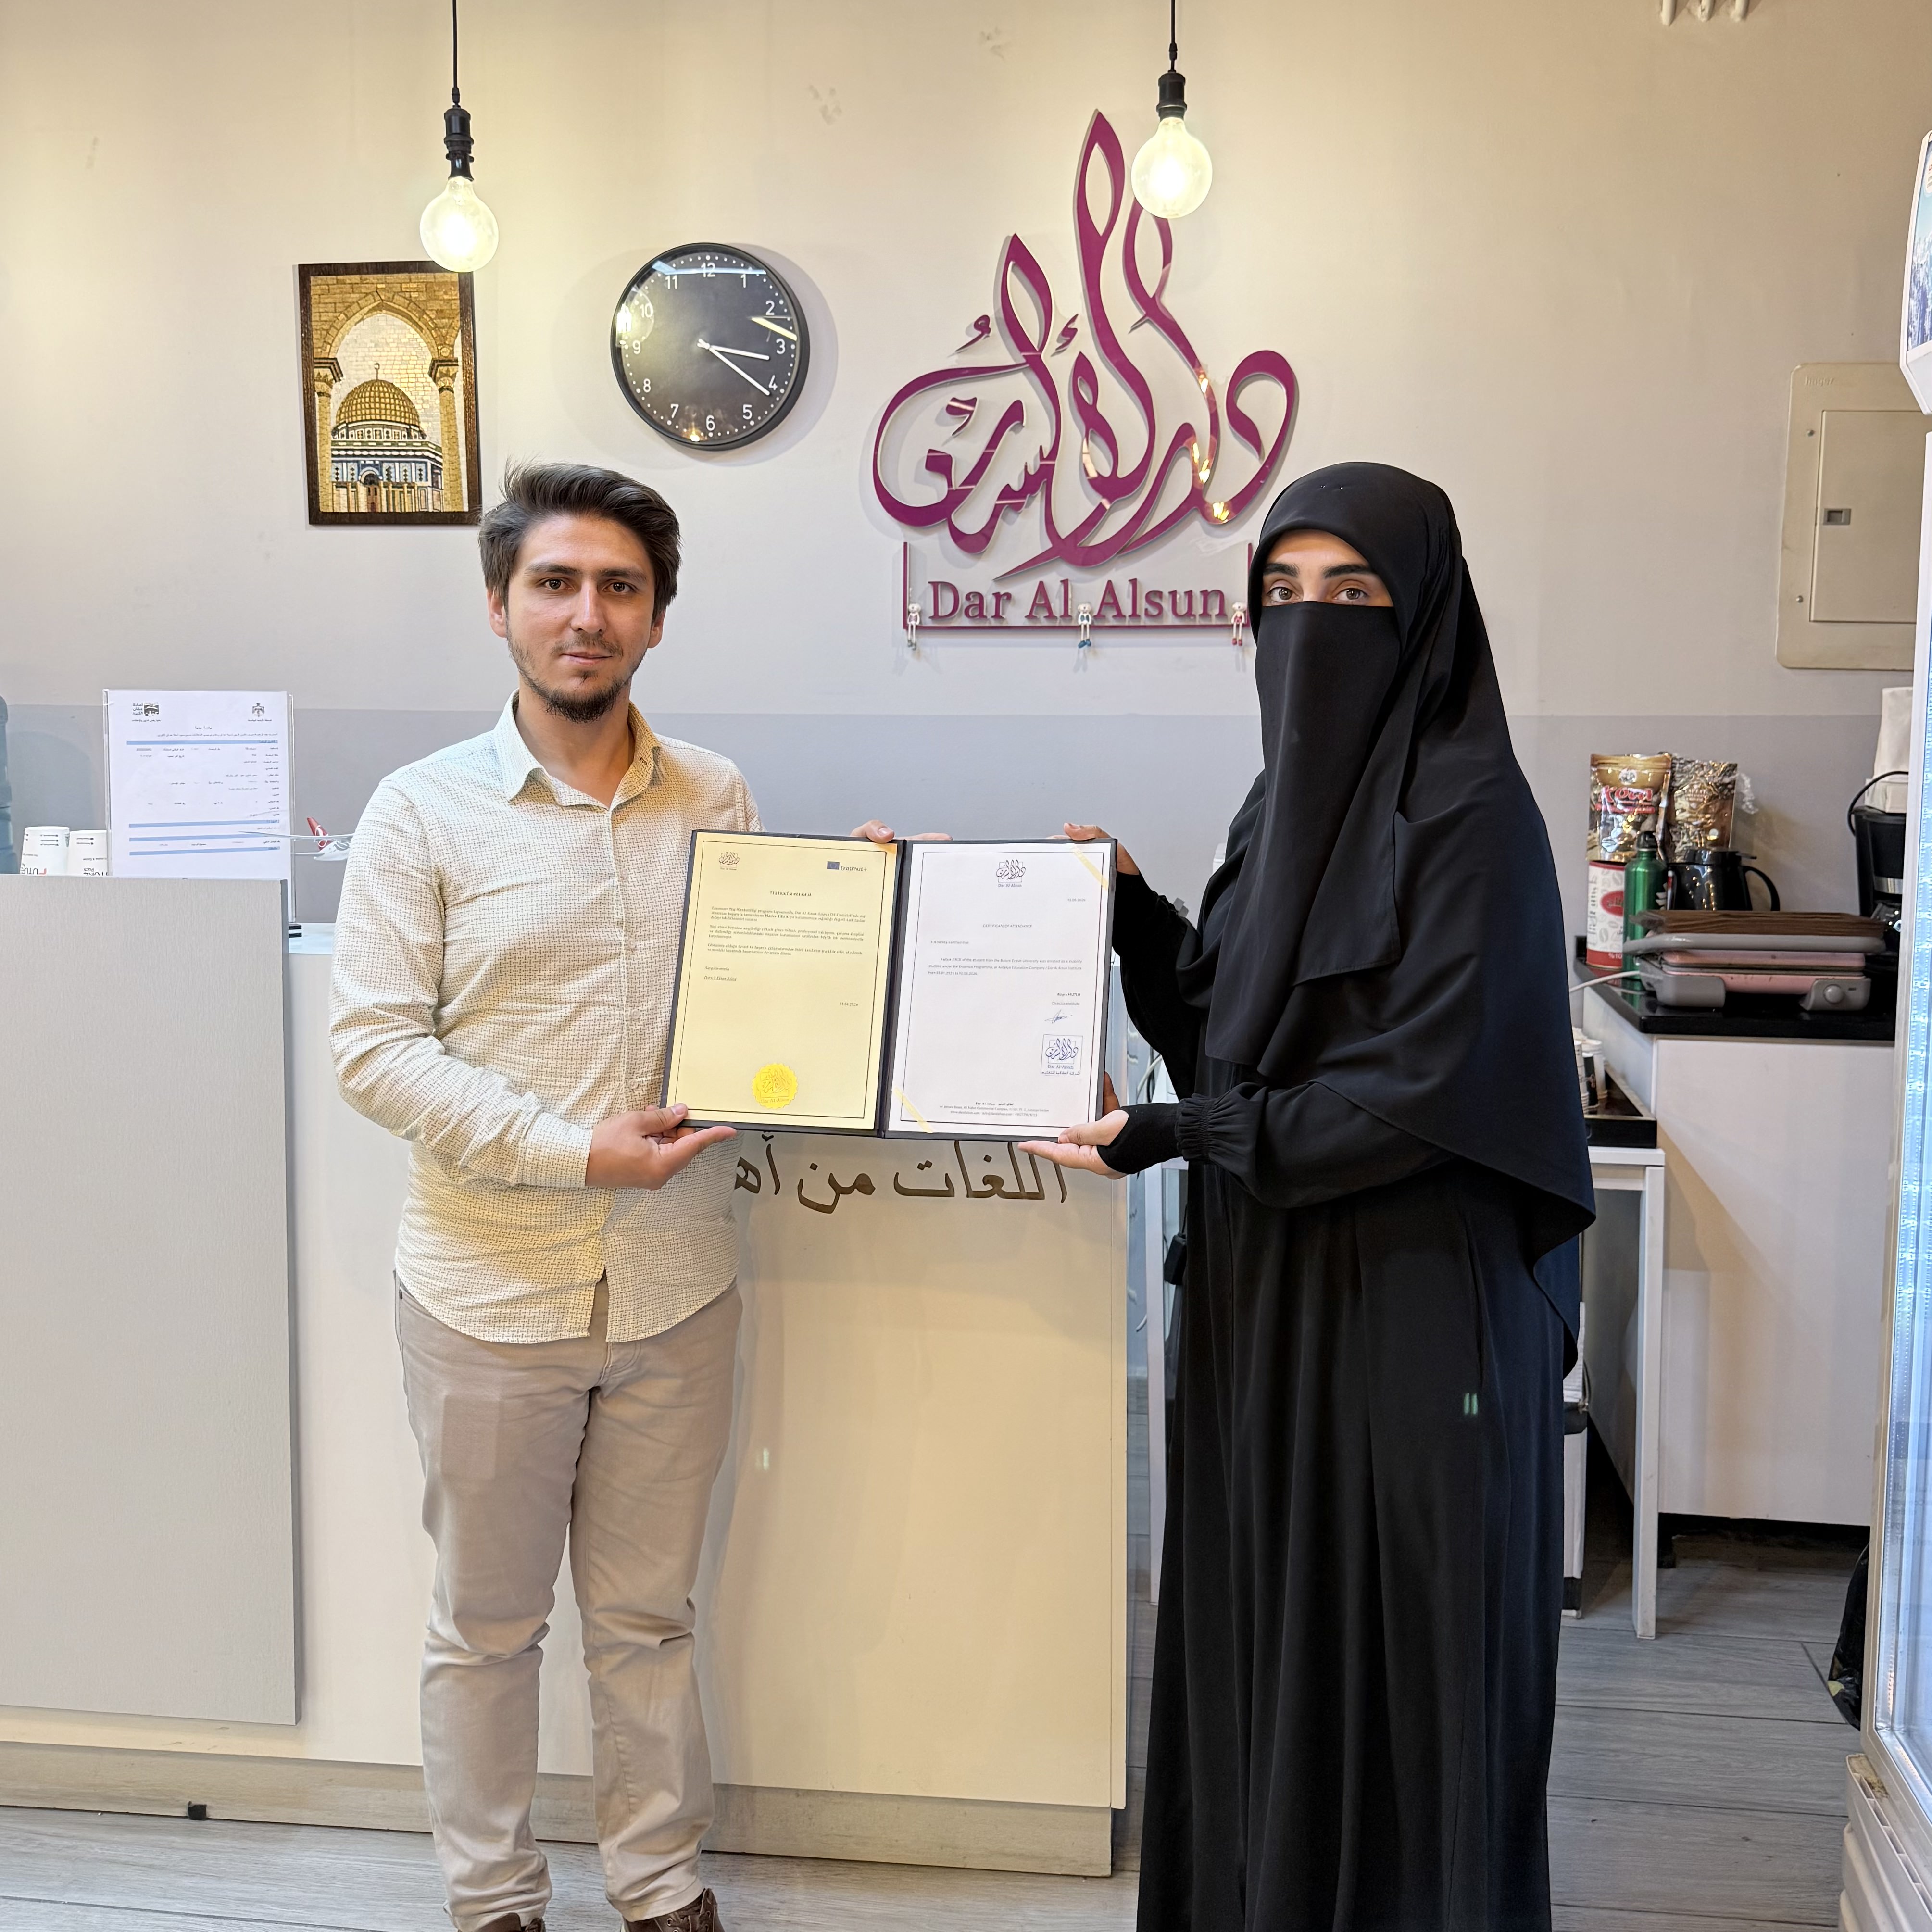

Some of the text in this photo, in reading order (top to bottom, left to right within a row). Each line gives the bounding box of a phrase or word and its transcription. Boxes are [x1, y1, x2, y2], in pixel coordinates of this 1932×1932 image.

[701, 262, 716, 278] 12
[665, 275, 678, 289] 11
[740, 274, 746, 288] 1
[640, 303, 653, 318] 10
[765, 301, 775, 316] 2
[632, 340, 641, 354] 9
[776, 339, 785, 354] 3
[643, 378, 651, 393] 8
[769, 375, 778, 390] 4
[670, 404, 679, 418] 7
[742, 404, 753, 420] 5
[706, 415, 715, 431] 6
[928, 578, 1227, 619] Dar Al Alsun
[798, 1163, 876, 1214] من
